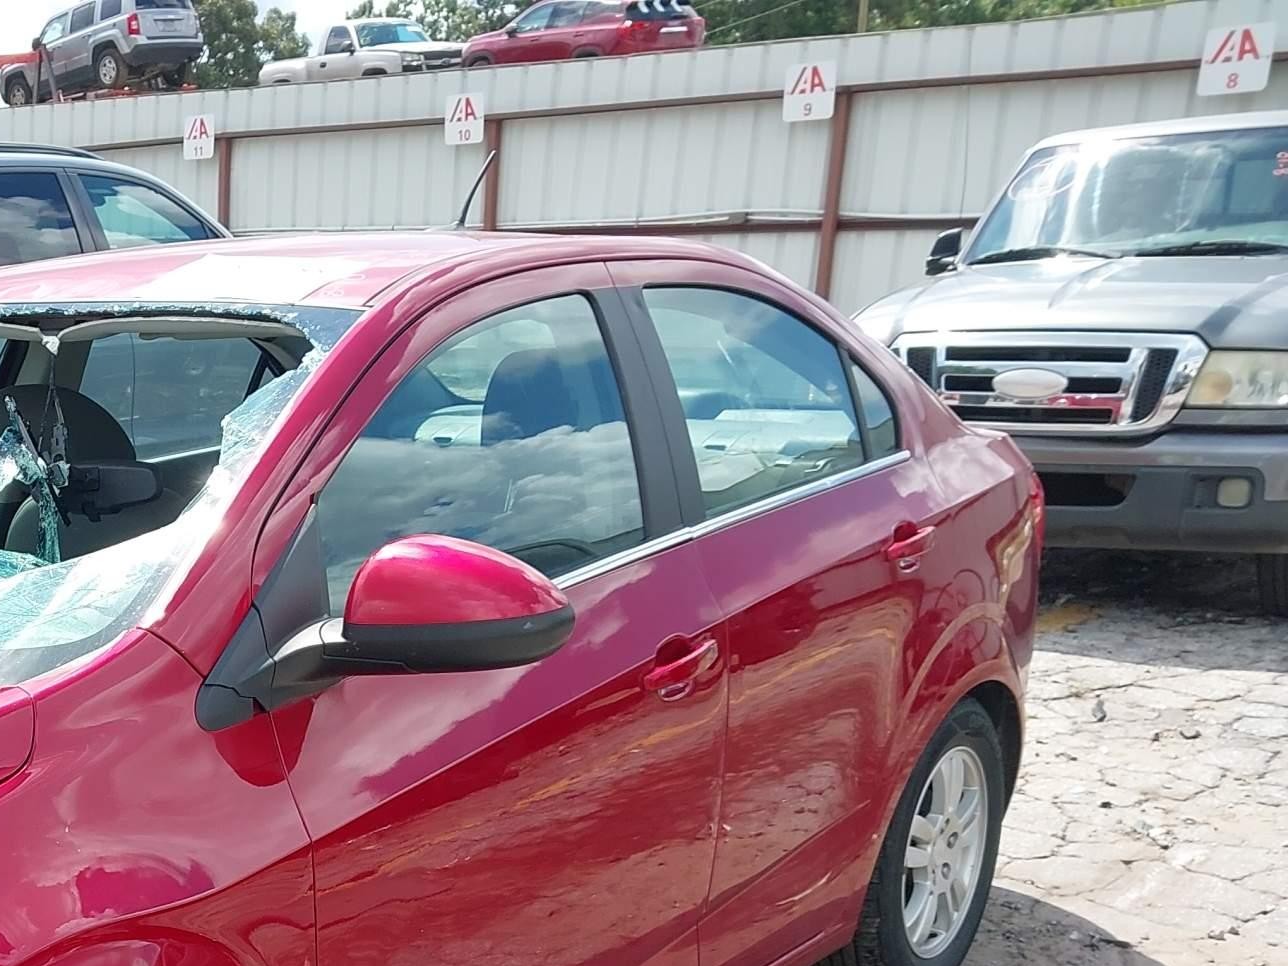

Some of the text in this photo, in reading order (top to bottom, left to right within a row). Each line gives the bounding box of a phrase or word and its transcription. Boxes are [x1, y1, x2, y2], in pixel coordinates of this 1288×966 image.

[1226, 72, 1239, 89] 8
[802, 103, 812, 117] 9
[457, 129, 471, 142] 10
[193, 145, 204, 157] 11
